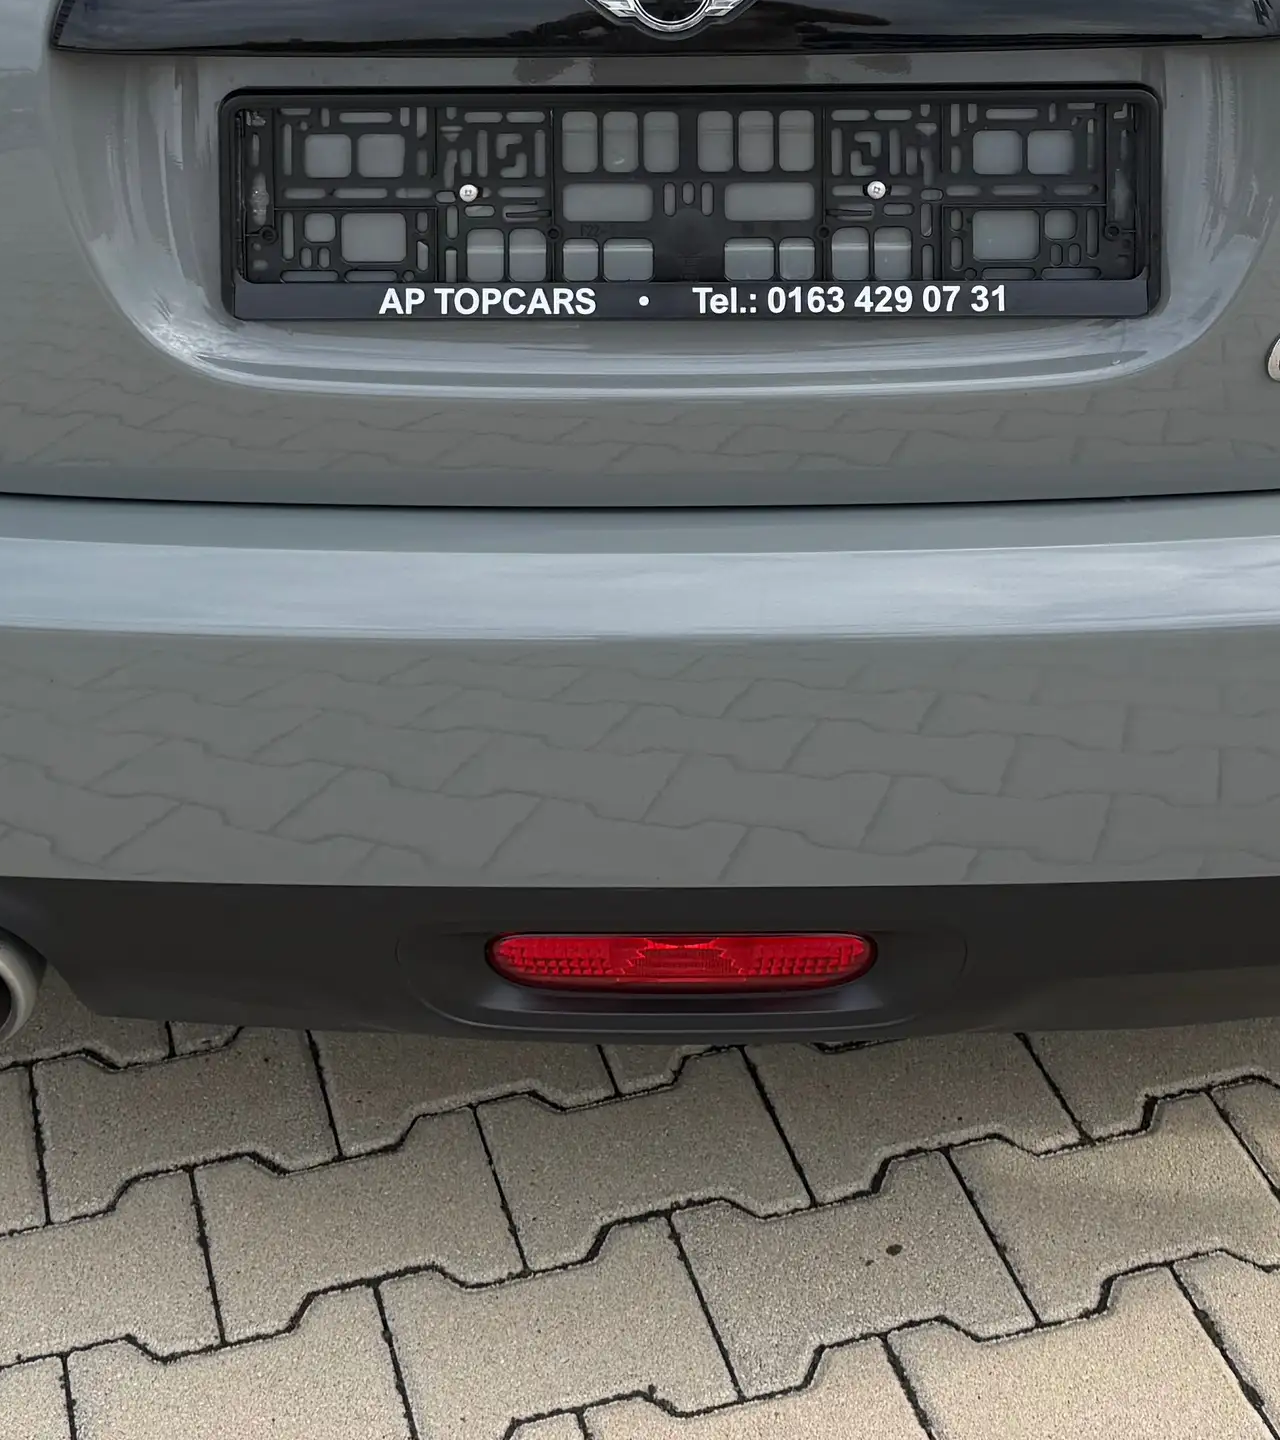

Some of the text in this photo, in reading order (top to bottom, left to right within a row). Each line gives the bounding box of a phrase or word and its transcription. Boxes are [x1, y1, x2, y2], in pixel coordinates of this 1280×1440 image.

[379, 284, 1005, 315] AP TOPCARS Tel.: 0163 429 07 31
